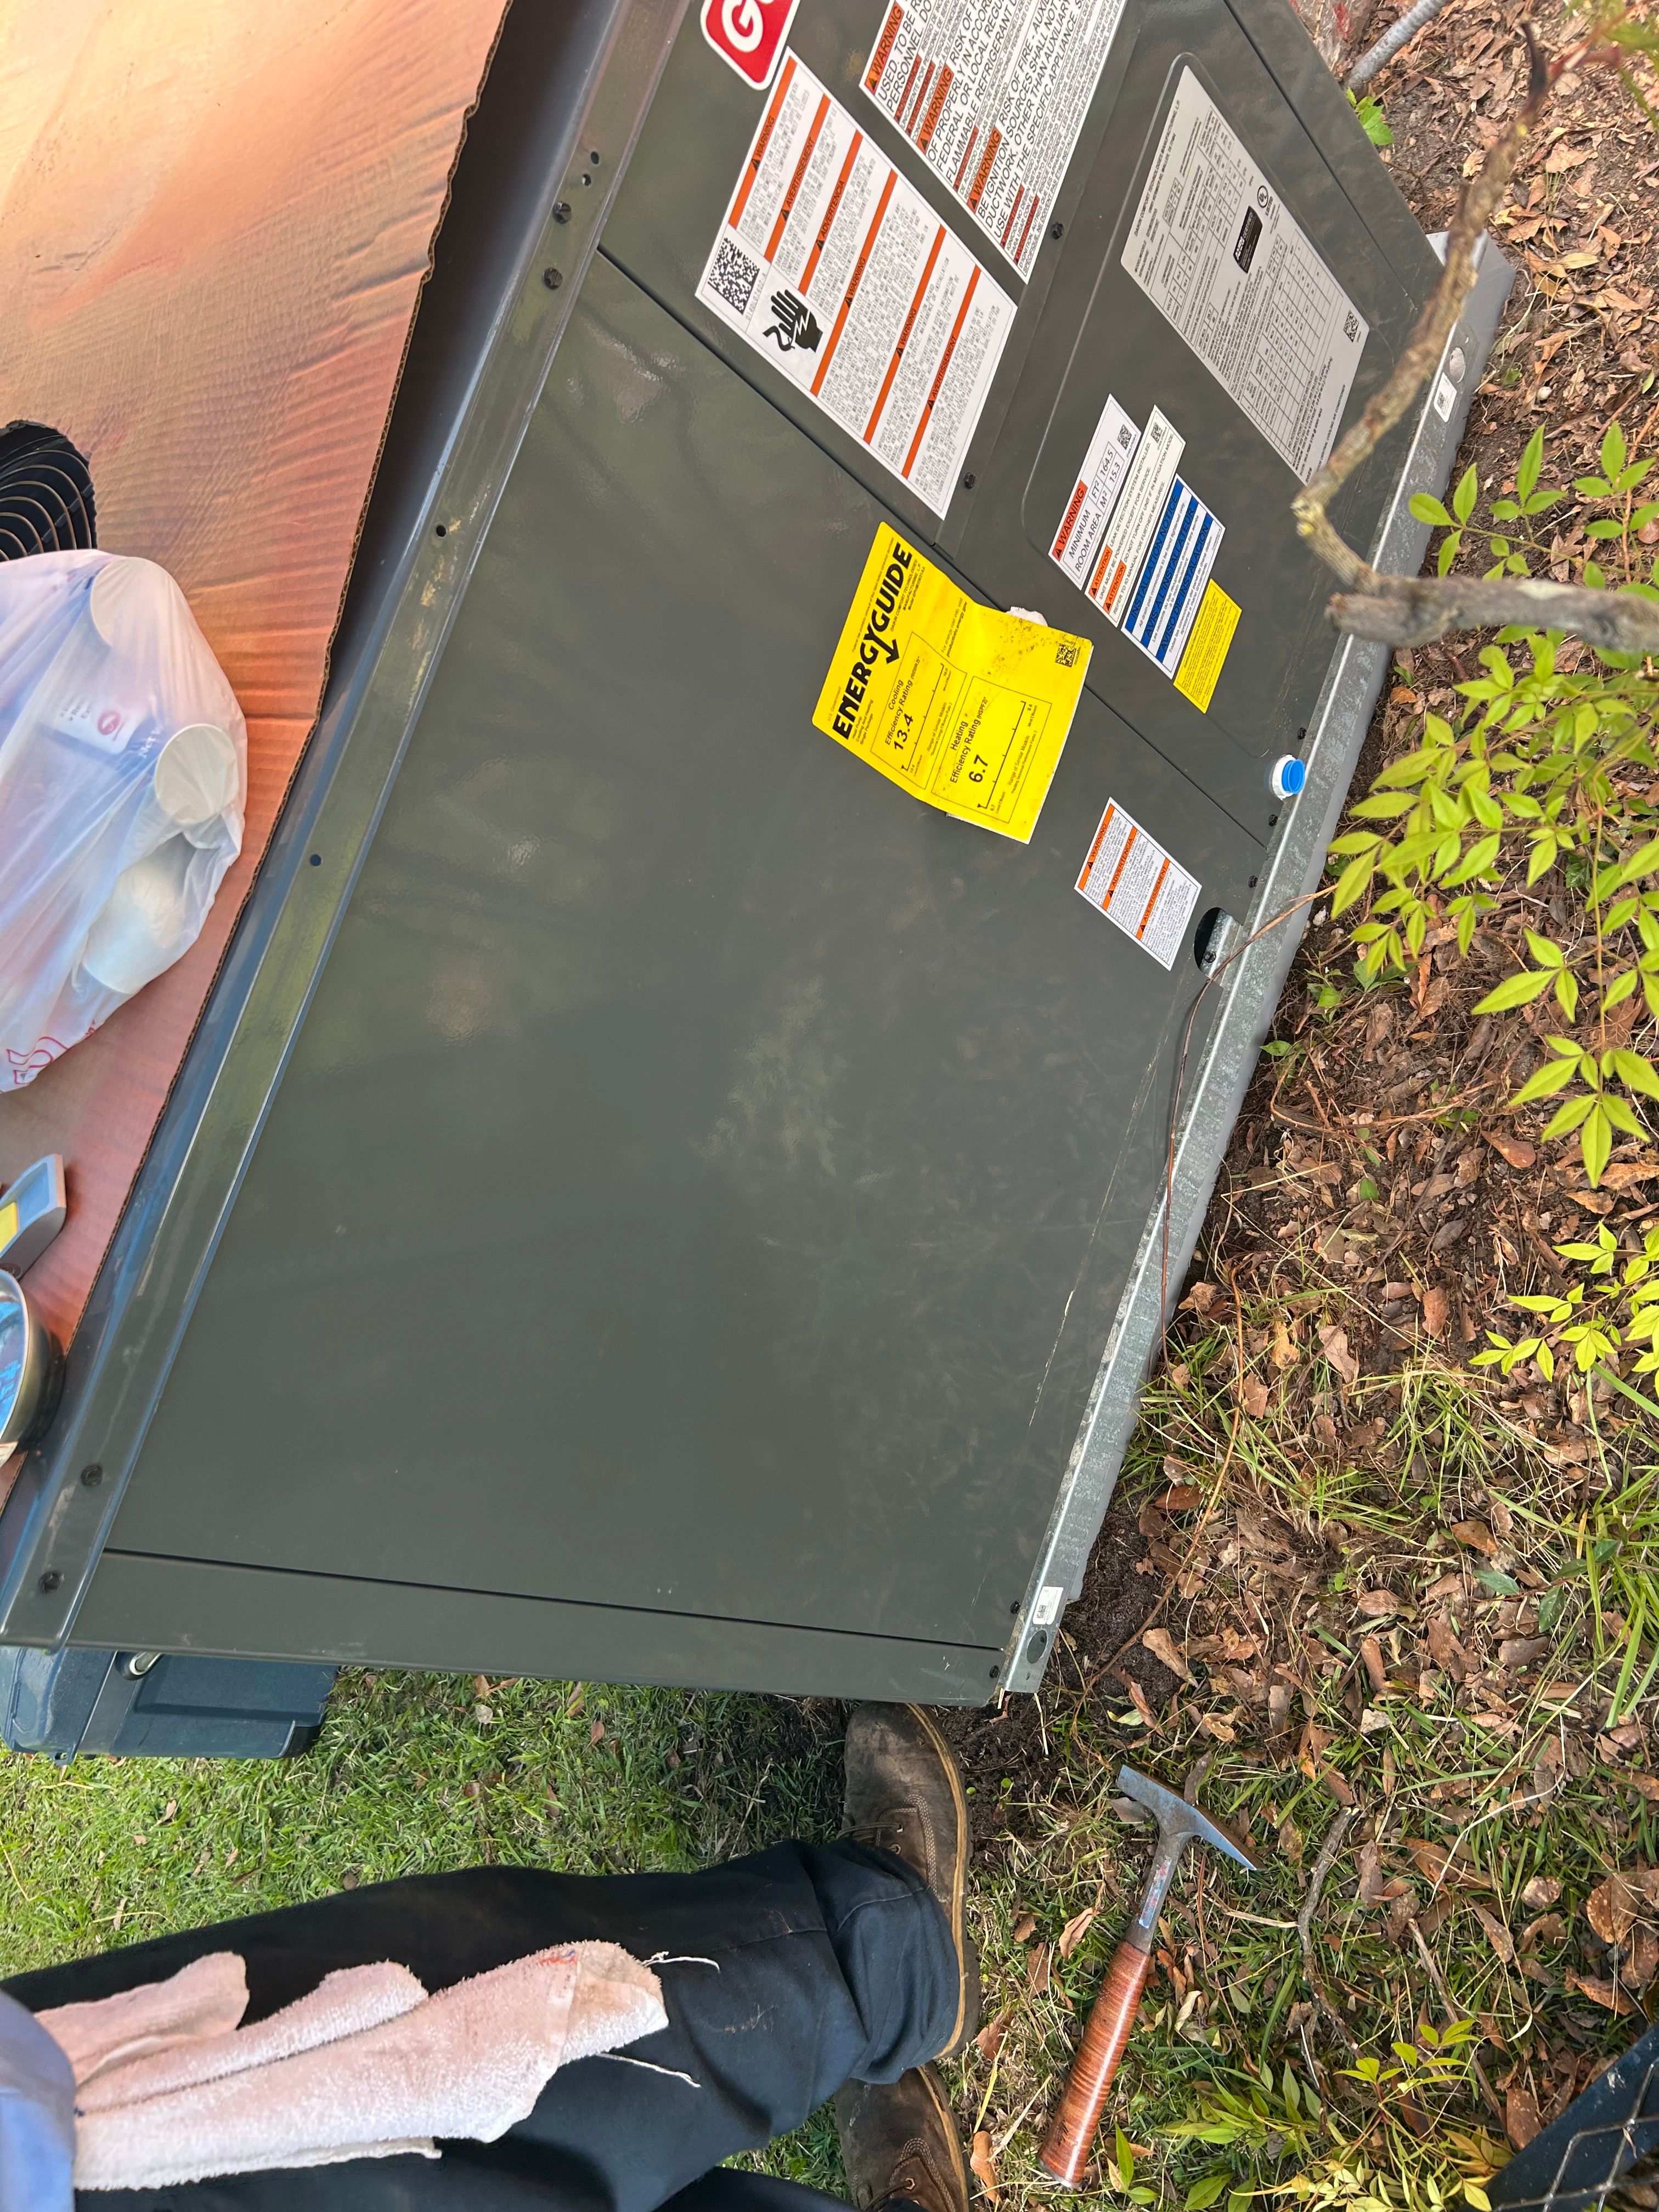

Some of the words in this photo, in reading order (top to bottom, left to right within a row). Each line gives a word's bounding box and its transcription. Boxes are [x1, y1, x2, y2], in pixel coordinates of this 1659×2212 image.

[871, 3, 903, 77] WARNING
[918, 0, 933, 24] DO
[877, 54, 900, 103] USED.
[894, 31, 908, 56] TO
[902, 10, 916, 35] BE
[923, 66, 952, 137] WARNING
[949, 28, 967, 66] RISK
[961, 7, 974, 32] OF
[926, 138, 940, 163] OF
[934, 64, 967, 142] PROPERLY
[961, 47, 973, 67] IN
[935, 106, 963, 172] FEDERAL
[959, 81, 973, 108] OR
[967, 36, 989, 84] LOCAL
[945, 99, 980, 184] FLAMMABLE
[974, 4, 1014, 103] REFRIGERANT
[973, 128, 1001, 197] WARNING
[998, 90, 1015, 127] RISK
[1009, 69, 1023, 94] OF
[1017, 37, 1034, 73] FIRE
[977, 195, 989, 219] BE
[984, 136, 1010, 199] IGNITION
[1005, 71, 1034, 139] SOURCES
[1028, 28, 1048, 75] SHALL
[1043, 0, 1059, 32] NOT
[755, 114, 775, 158] WARNING
[984, 145, 1018, 229] DUCTWORK,
[1013, 97, 1035, 148] OTHER
[1030, 60, 1048, 100] THAN
[993, 207, 1008, 239] USE
[1003, 171, 1021, 211] WITH
[1016, 143, 1031, 174] THE
[1026, 82, 1052, 146] SPECIFIC
[785, 136, 815, 208] AVERTISSEMENT
[819, 178, 845, 239] ADVERTENCIA
[1264, 195, 1274, 217] LISTED
[848, 255, 866, 297] WARNING
[899, 307, 917, 347] WARNING
[931, 333, 957, 399] AVERTISSEMENT
[1099, 447, 1114, 478] 164.5
[1108, 460, 1120, 484] 15.3
[1150, 482, 1155, 491] IN
[1153, 449, 1167, 484] MITIGATION
[1058, 486, 1085, 546] WARNING
[1109, 530, 1118, 548] LEAK
[1115, 496, 1130, 532] DETECTION
[1127, 473, 1139, 499] SYSTEM
[1148, 489, 1153, 498] IF
[1068, 508, 1091, 559] MINIMUM
[1075, 538, 1091, 573] ROOM
[1087, 510, 1101, 540] AREA
[1104, 567, 1113, 585] MUST
[1110, 558, 1116, 568] BE
[1114, 528, 1127, 560] POWERED
[1125, 505, 1136, 529] EXCEPT
[1123, 552, 1129, 563] DO
[1130, 536, 1163, 619] INSTALLATION
[1159, 493, 1178, 538] NOTICE
[1132, 522, 1140, 540] TURN
[1094, 549, 1110, 587] ATTENTION
[1108, 564, 1124, 602] ATTENTION
[1113, 593, 1122, 614] REFER
[1121, 584, 1126, 594] TO
[1126, 553, 1137, 578] MANUAL
[1141, 512, 1153, 541] FURTHER
[831, 541, 915, 740] ENERGYGUIDE
[1144, 608, 1159, 637] AVIS
[1160, 614, 1177, 652] AVISO
[1172, 596, 1183, 616] DE
[884, 705, 904, 746] Efficiency
[898, 678, 913, 707] Rating
[887, 678, 904, 711] Cooling
[892, 712, 915, 753] 13.4
[949, 720, 968, 751] Heating
[949, 744, 972, 784] Efficiency
[963, 718, 981, 745] Rating
[967, 753, 990, 784] 6.7
[1090, 822, 1107, 858] WARNING
[1110, 837, 1133, 887] ADVERTENCIA
[1142, 866, 1167, 922] AVERTISSEMENT
